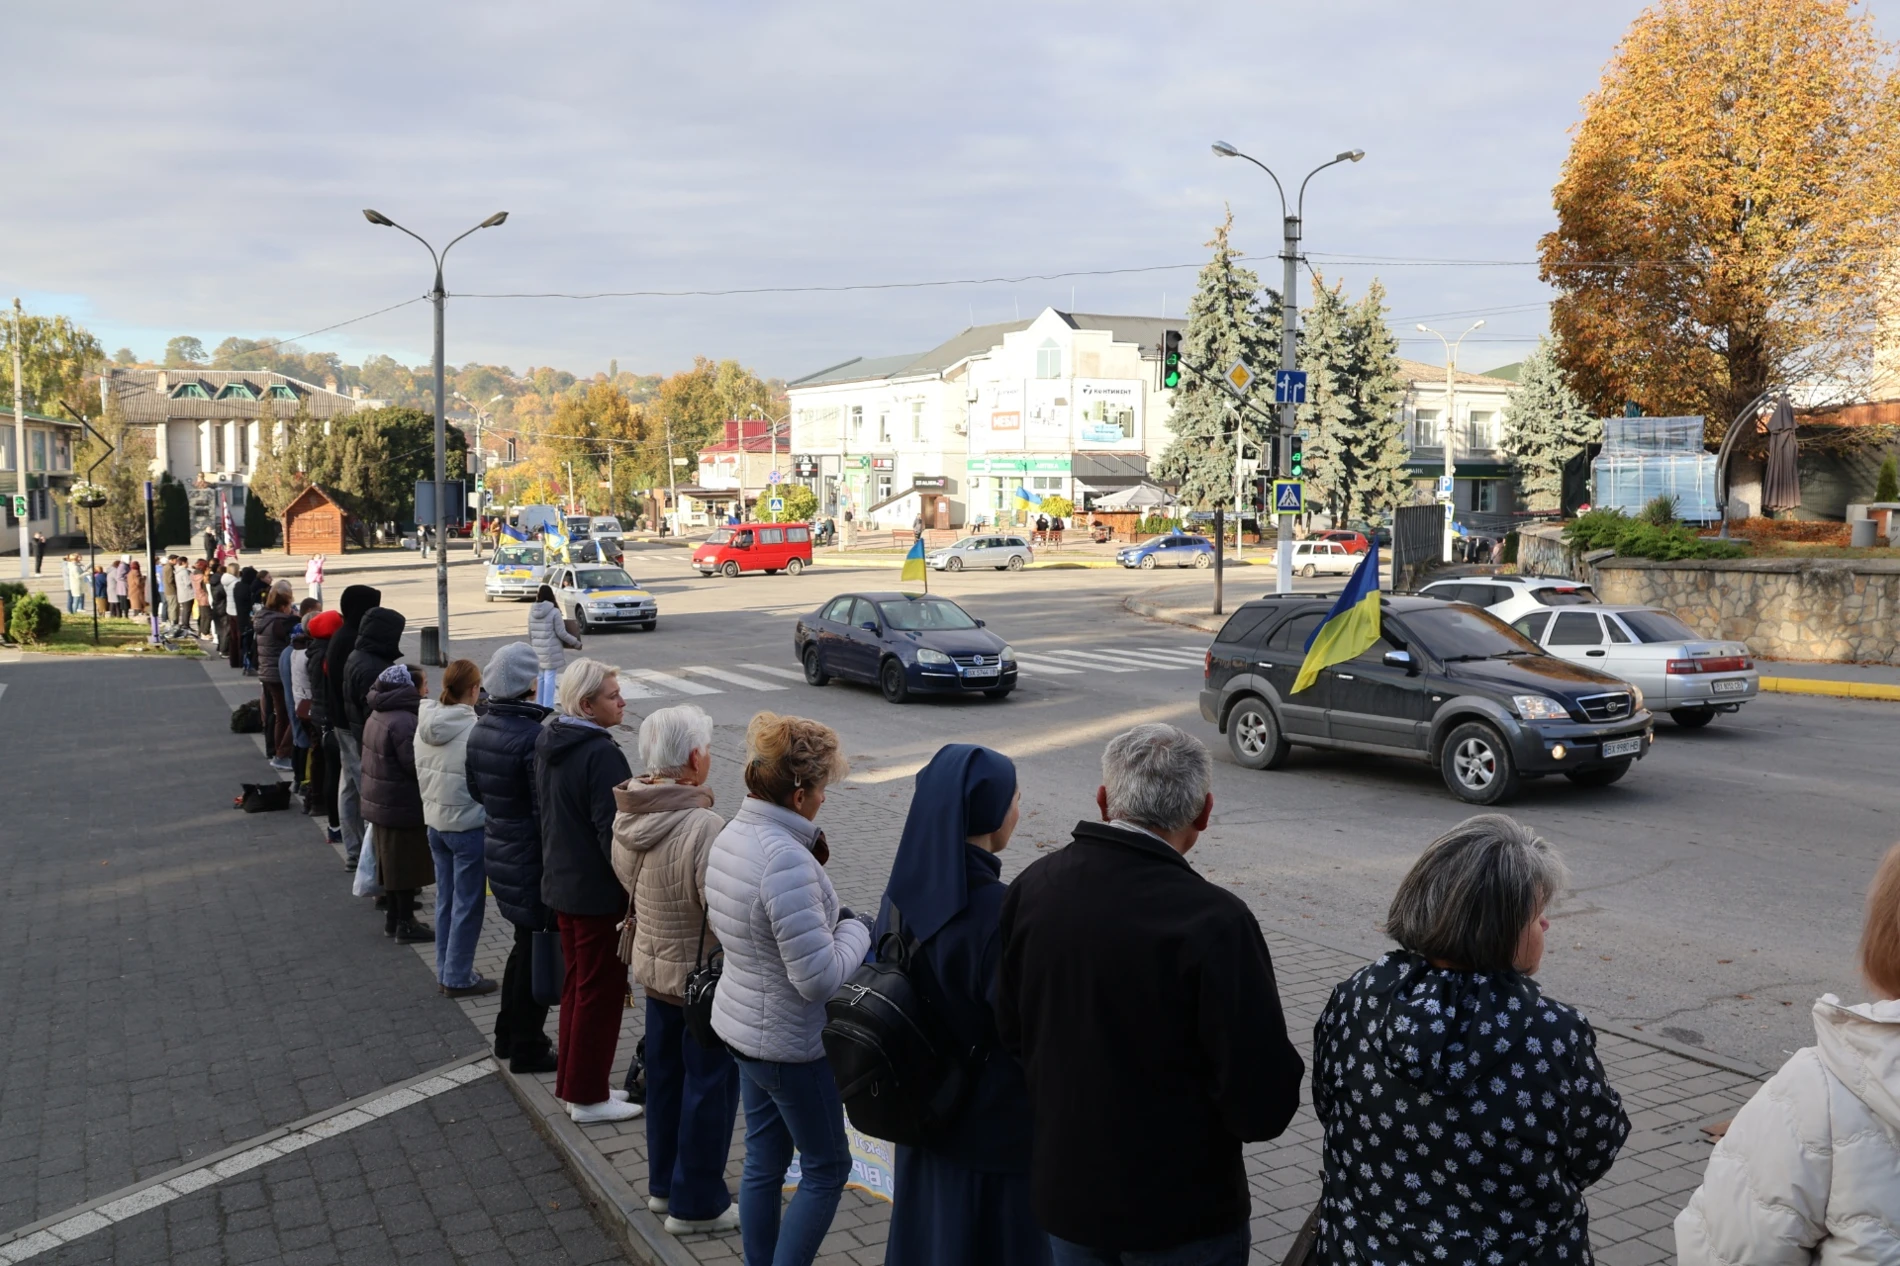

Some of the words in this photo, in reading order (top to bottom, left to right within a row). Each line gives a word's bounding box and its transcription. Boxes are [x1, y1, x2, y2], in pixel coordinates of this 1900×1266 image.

[994, 415, 1018, 427] МЕБЛІ
[1442, 479, 1451, 491] P
[1607, 744, 1616, 755] BX
[1616, 742, 1630, 753] 9980
